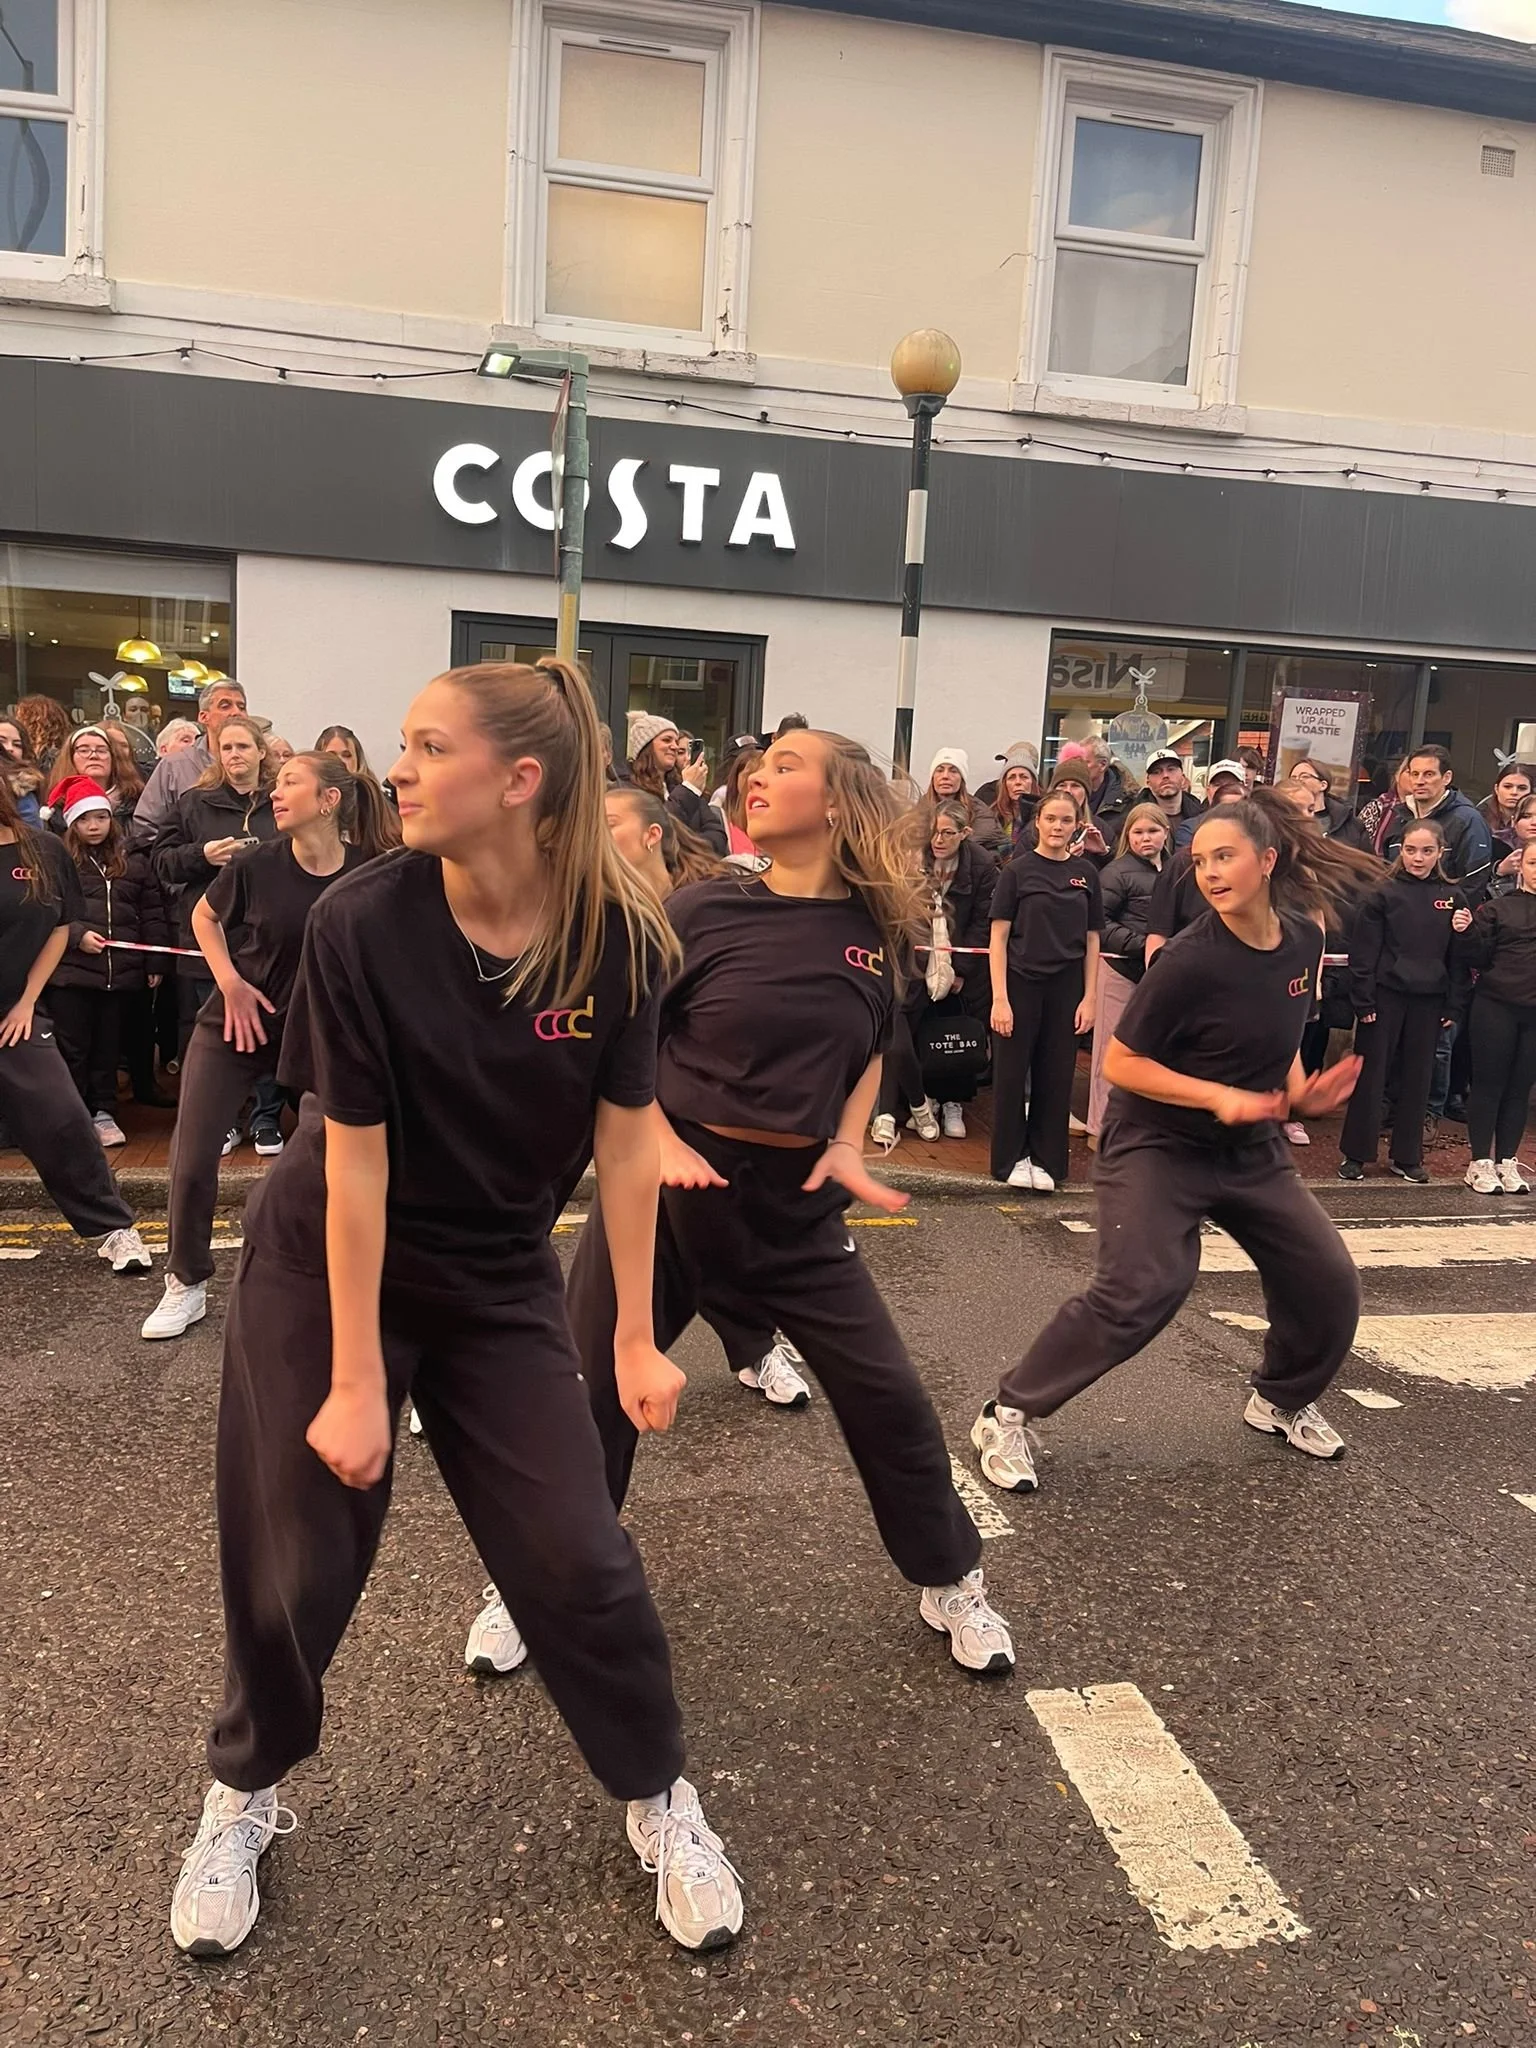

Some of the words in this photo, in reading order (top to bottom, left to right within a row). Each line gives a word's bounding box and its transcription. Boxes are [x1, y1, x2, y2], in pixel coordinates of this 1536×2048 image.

[433, 443, 796, 550] COSTA
[1296, 706, 1346, 717] WRAPPED
[1301, 716, 1315, 725] UP
[1317, 716, 1337, 726] ALL
[1296, 725, 1341, 736] TOASTIE
[944, 1033, 961, 1041] THE
[929, 1041, 953, 1050] TOTE
[959, 1040, 977, 1048] BAG
